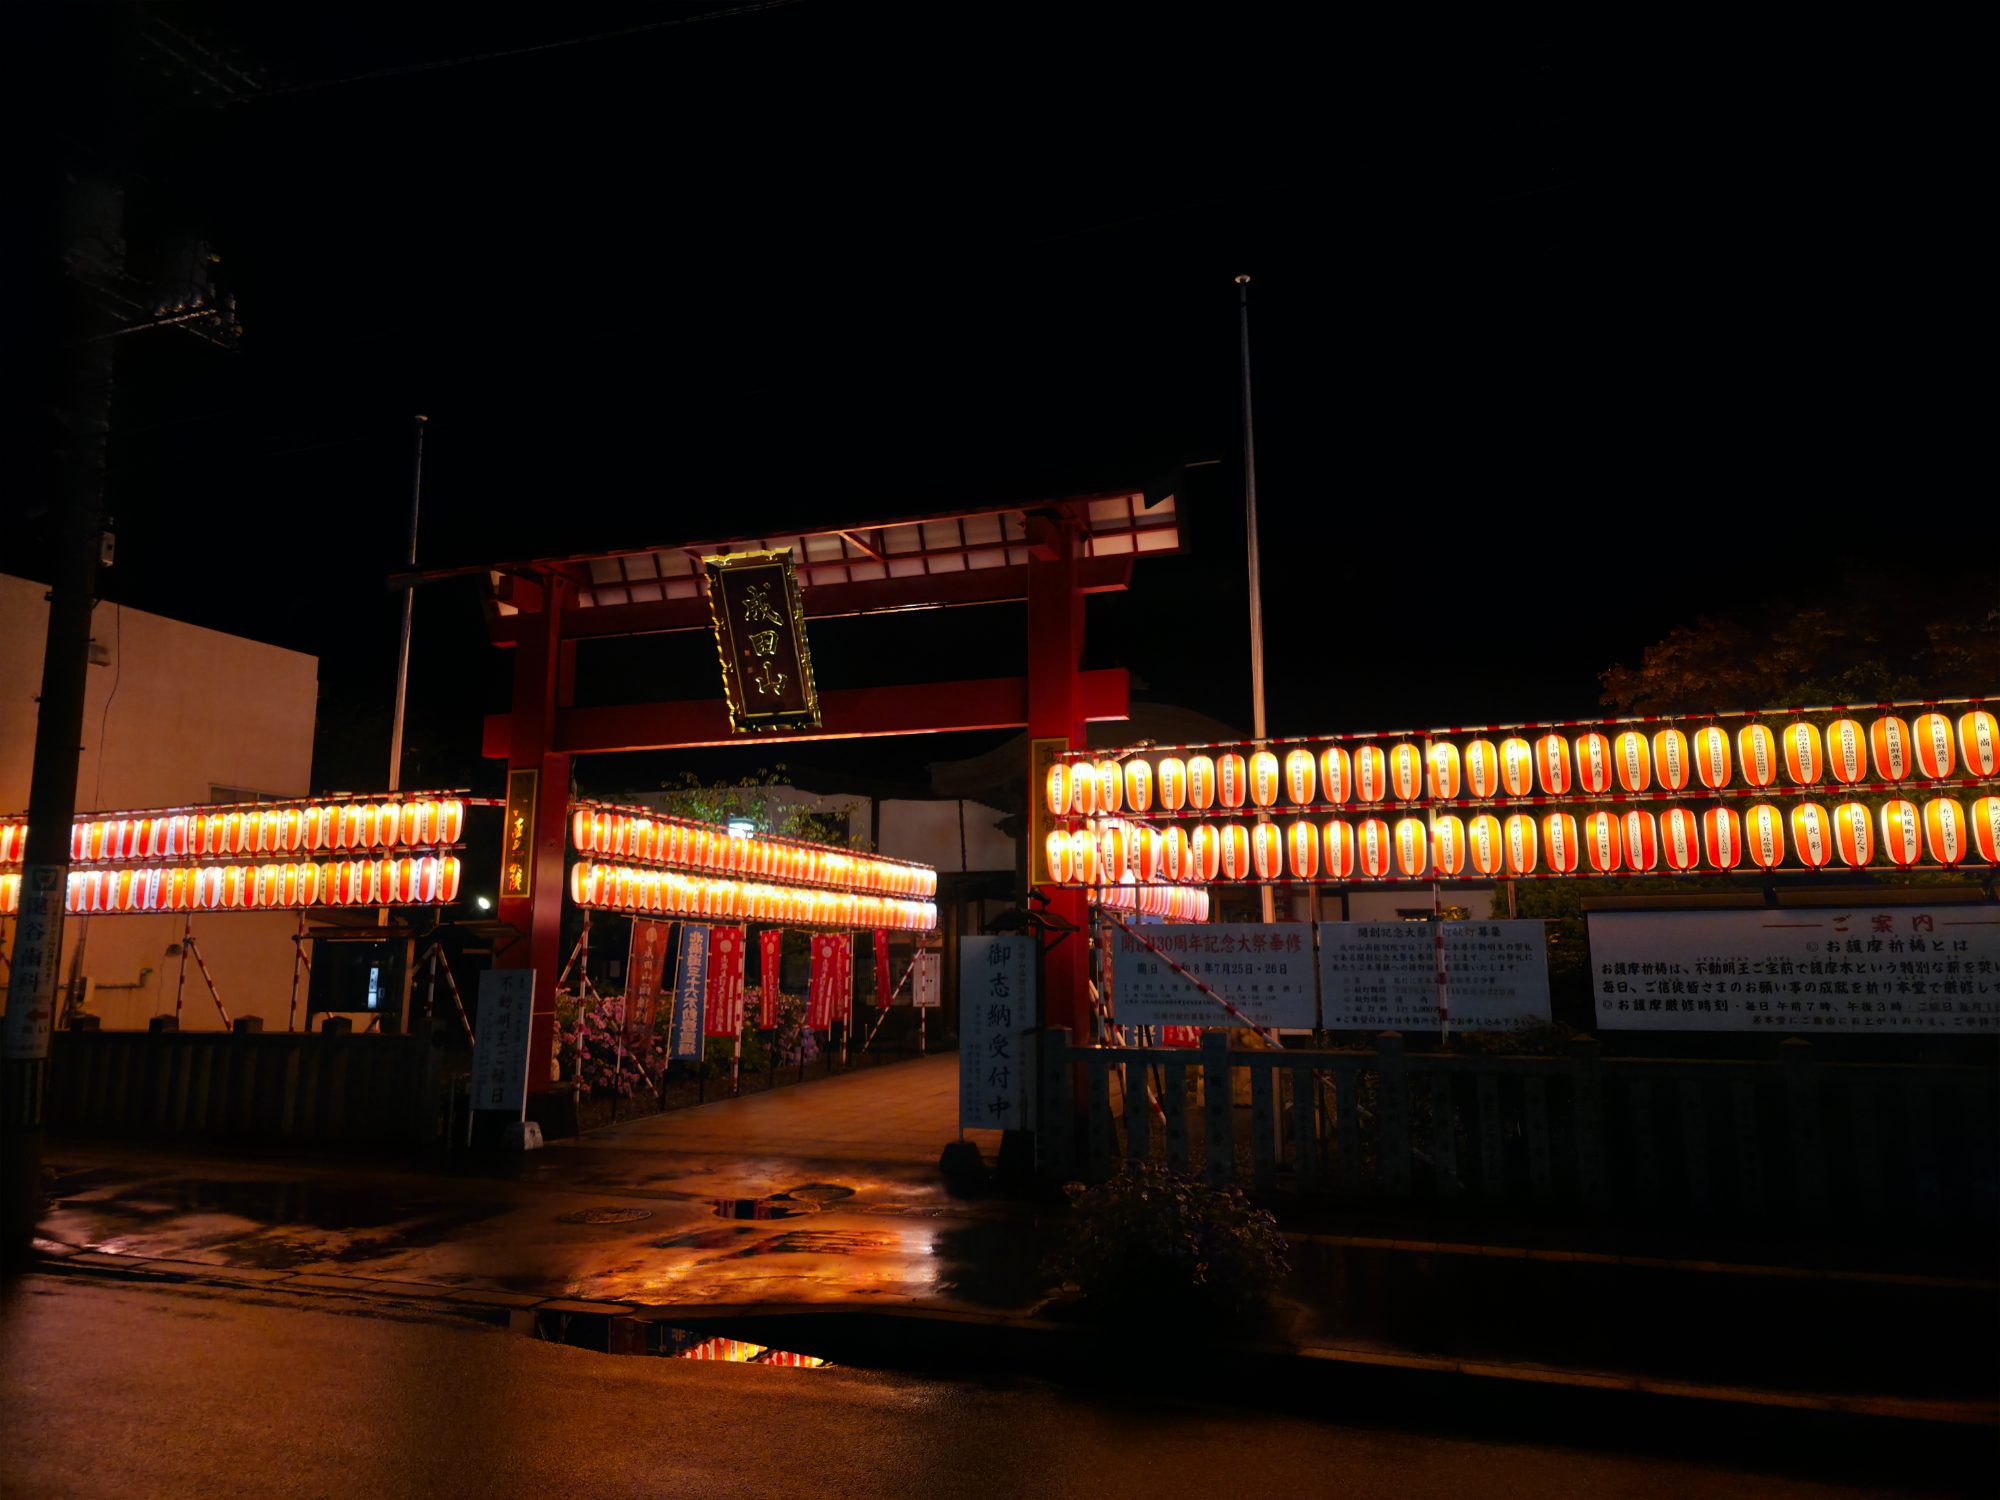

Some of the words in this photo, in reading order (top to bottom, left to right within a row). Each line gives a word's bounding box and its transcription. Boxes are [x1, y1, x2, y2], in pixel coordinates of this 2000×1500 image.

[742, 582, 790, 697] 成田山
[1903, 808, 1915, 846] 松風町会
[1833, 914, 1934, 933] ご案内
[1137, 963, 1158, 975] 期日
[1172, 962, 1287, 975] 和8年7月25日・26日
[987, 943, 1011, 1121] 御志納受付中
